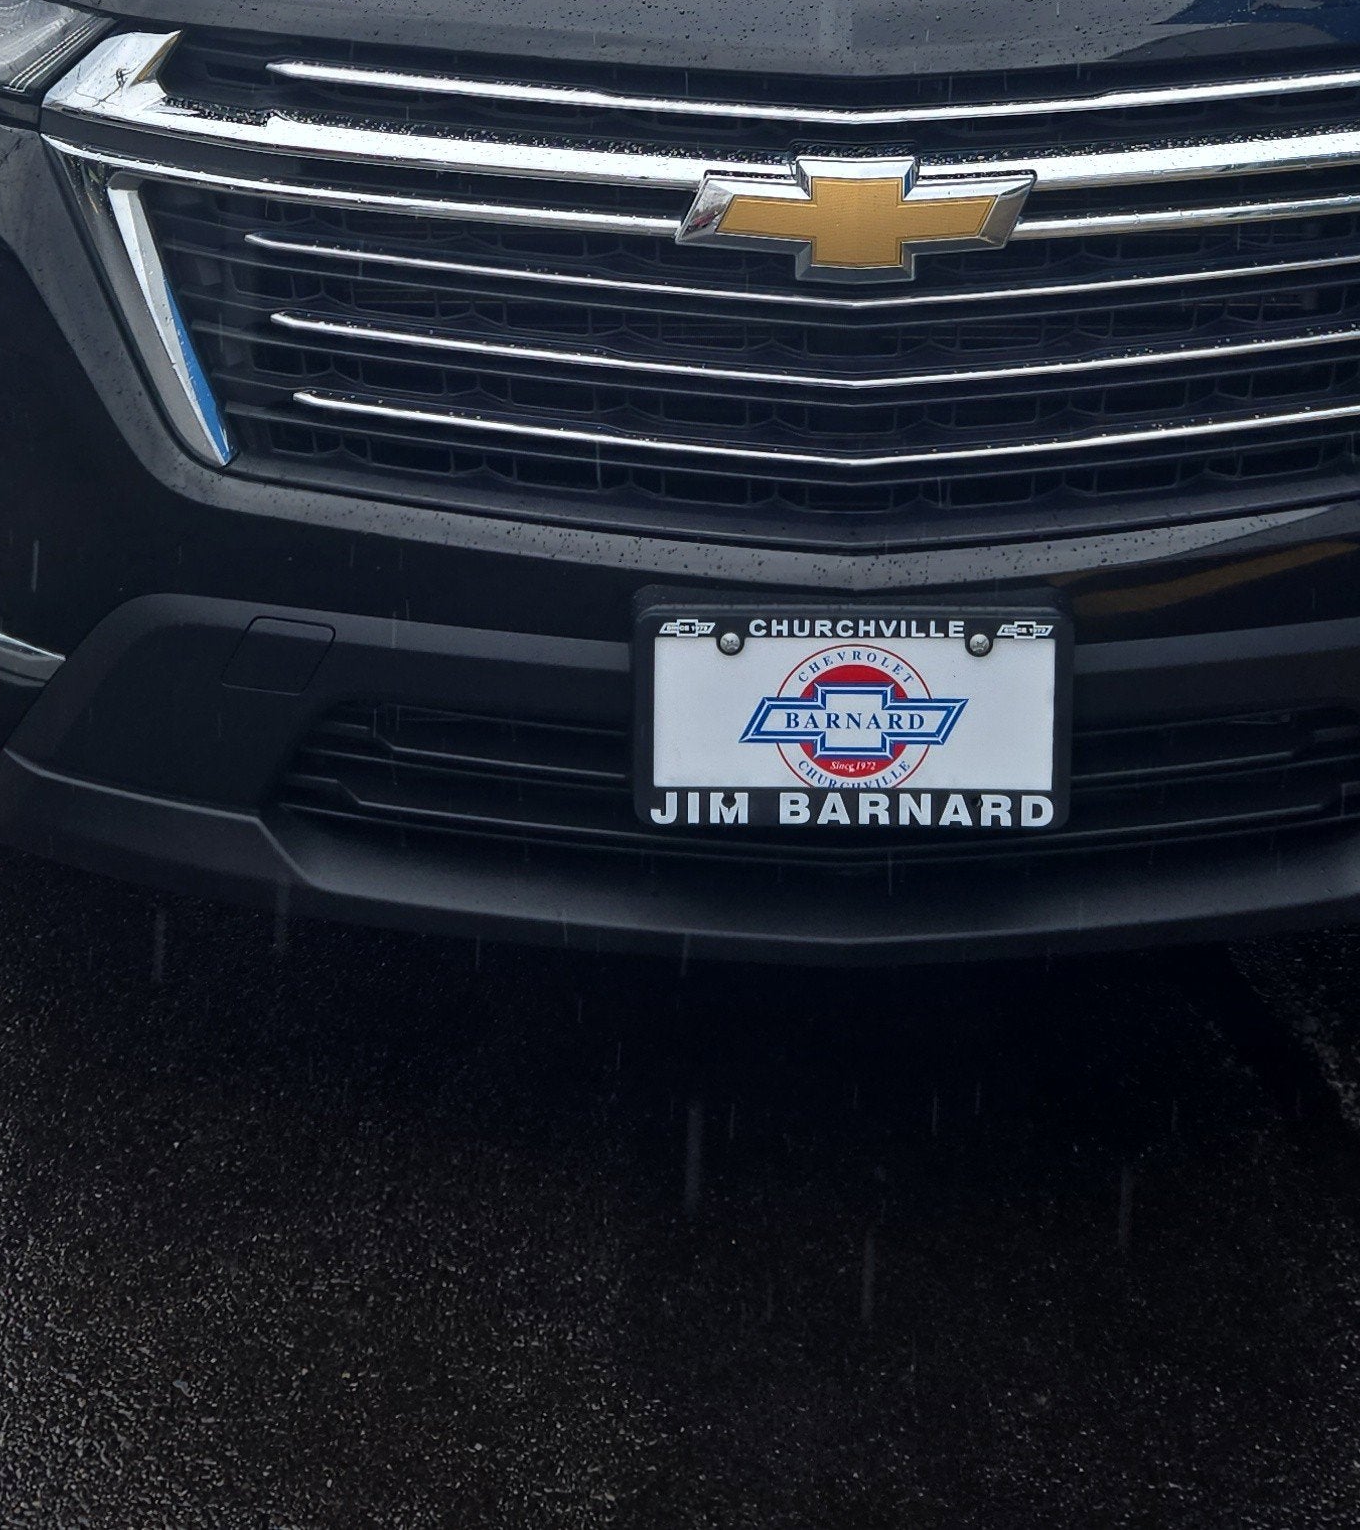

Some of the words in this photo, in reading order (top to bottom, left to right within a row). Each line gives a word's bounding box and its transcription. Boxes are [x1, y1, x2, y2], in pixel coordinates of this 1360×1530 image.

[748, 619, 965, 638] CHURCHVILLE
[798, 650, 915, 683] CHEVROLET
[785, 711, 925, 730] BARNARD
[829, 761, 854, 771] Since
[855, 761, 877, 771] 1972
[650, 791, 749, 825] JIM
[778, 791, 1055, 828] BARNARD
